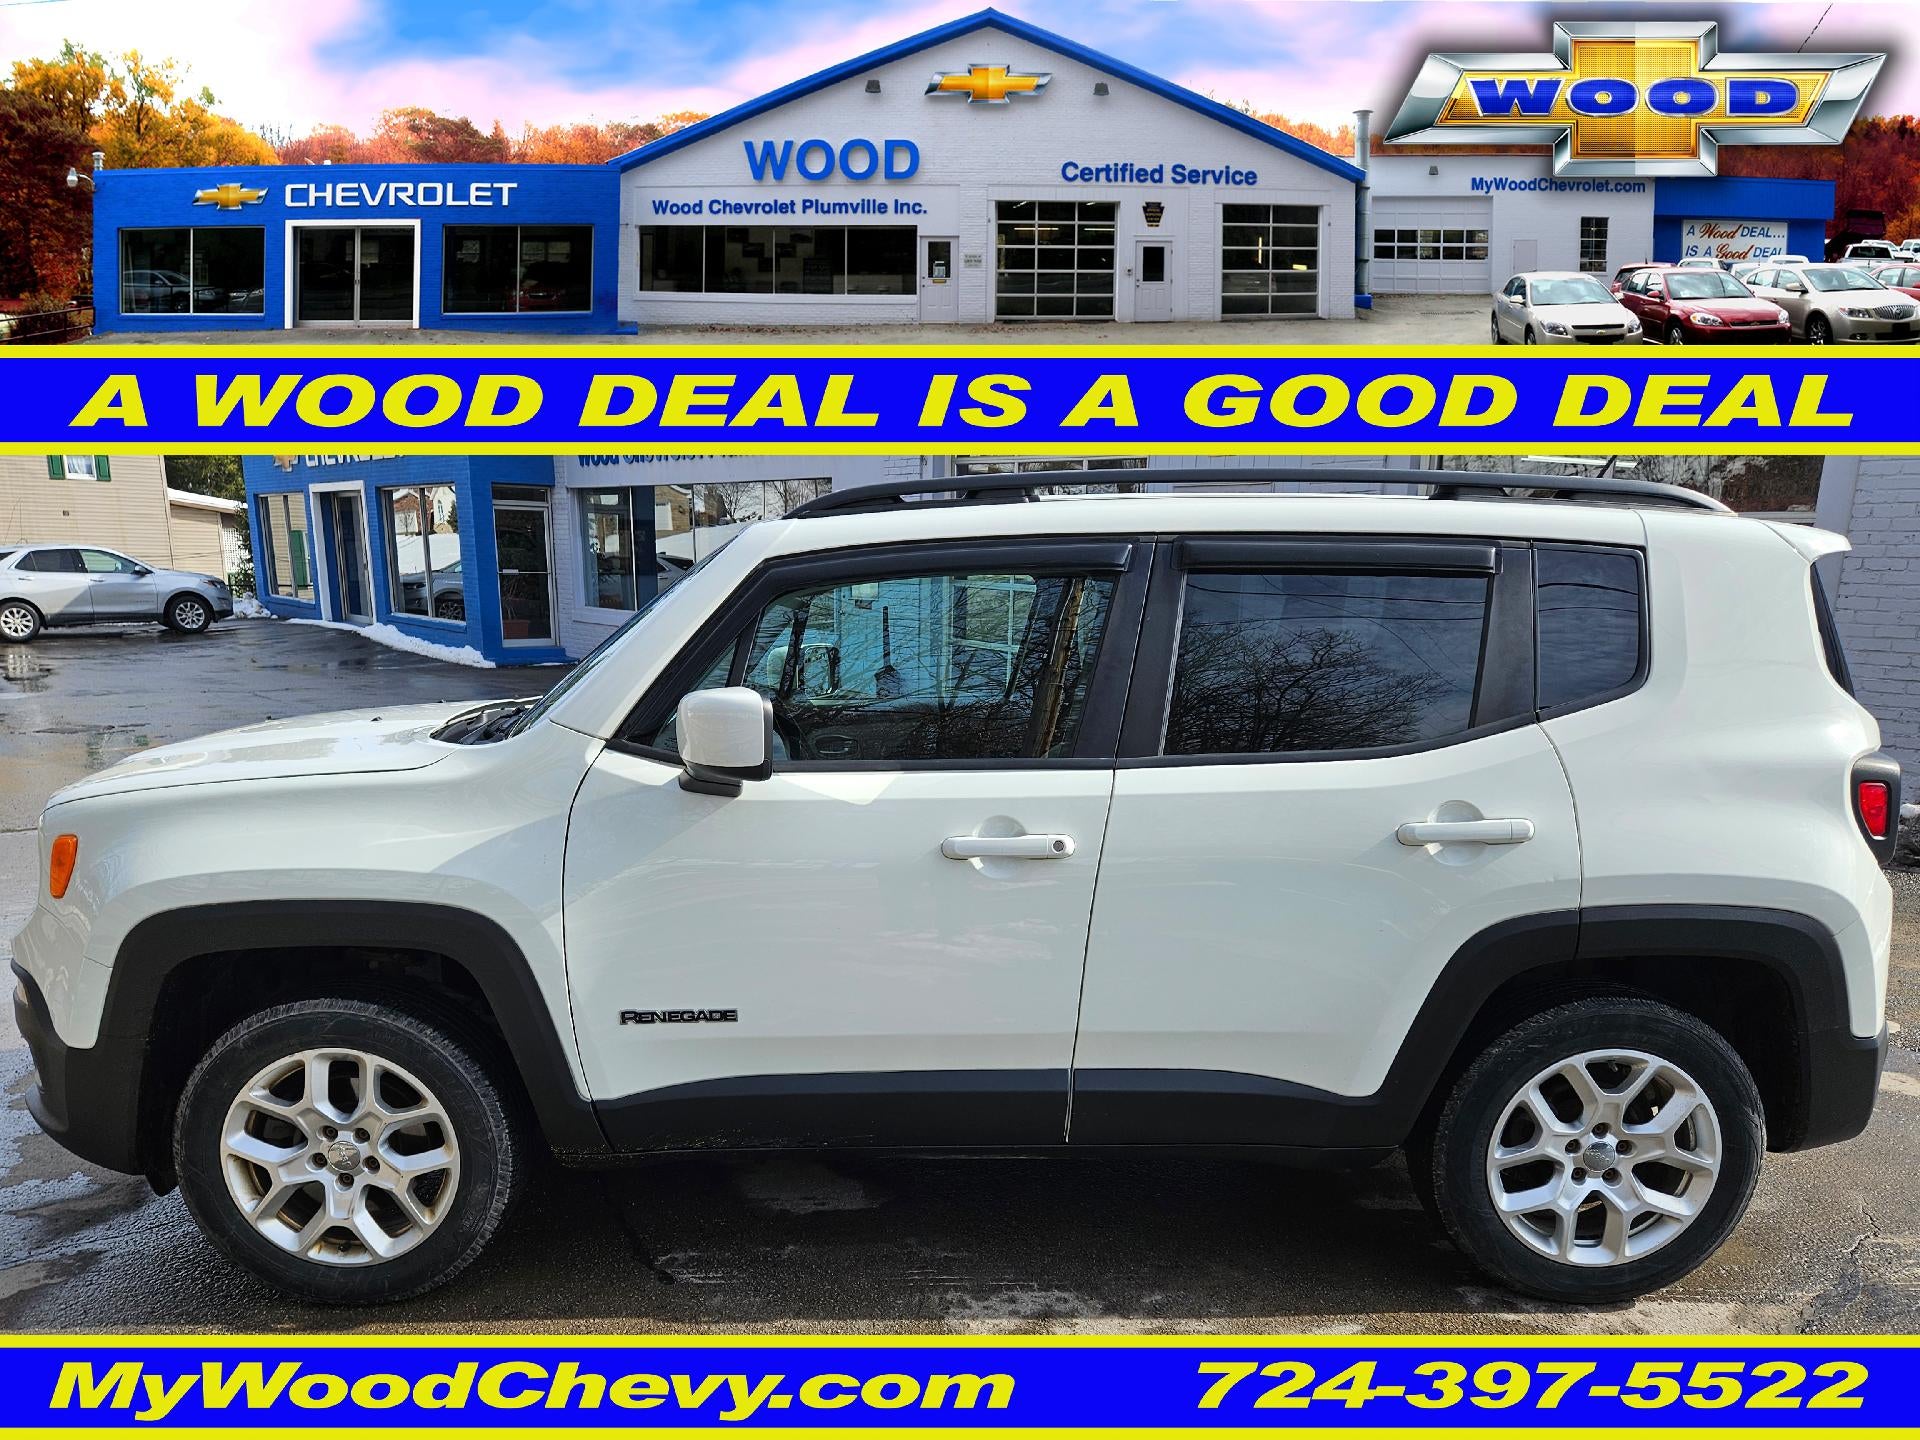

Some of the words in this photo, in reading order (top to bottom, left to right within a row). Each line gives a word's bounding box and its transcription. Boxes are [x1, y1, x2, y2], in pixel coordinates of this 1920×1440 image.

[744, 139, 920, 181] WOOD
[1061, 161, 1163, 184] Certified
[1171, 163, 1257, 186] Service
[1471, 177, 1646, 194] MyWoodChevrolet.com
[285, 183, 517, 207] CHEVROLET
[652, 199, 703, 215] Wood
[708, 199, 796, 215] Chevrolet
[801, 199, 889, 215] Plumville
[894, 199, 928, 215] Inc.
[1687, 225, 1695, 236] A
[1699, 223, 1743, 239] Wood
[1685, 245, 1699, 257] IS
[1703, 246, 1712, 257] A
[1715, 243, 1755, 260] Good
[620, 1009, 738, 1025] RENEGADE
